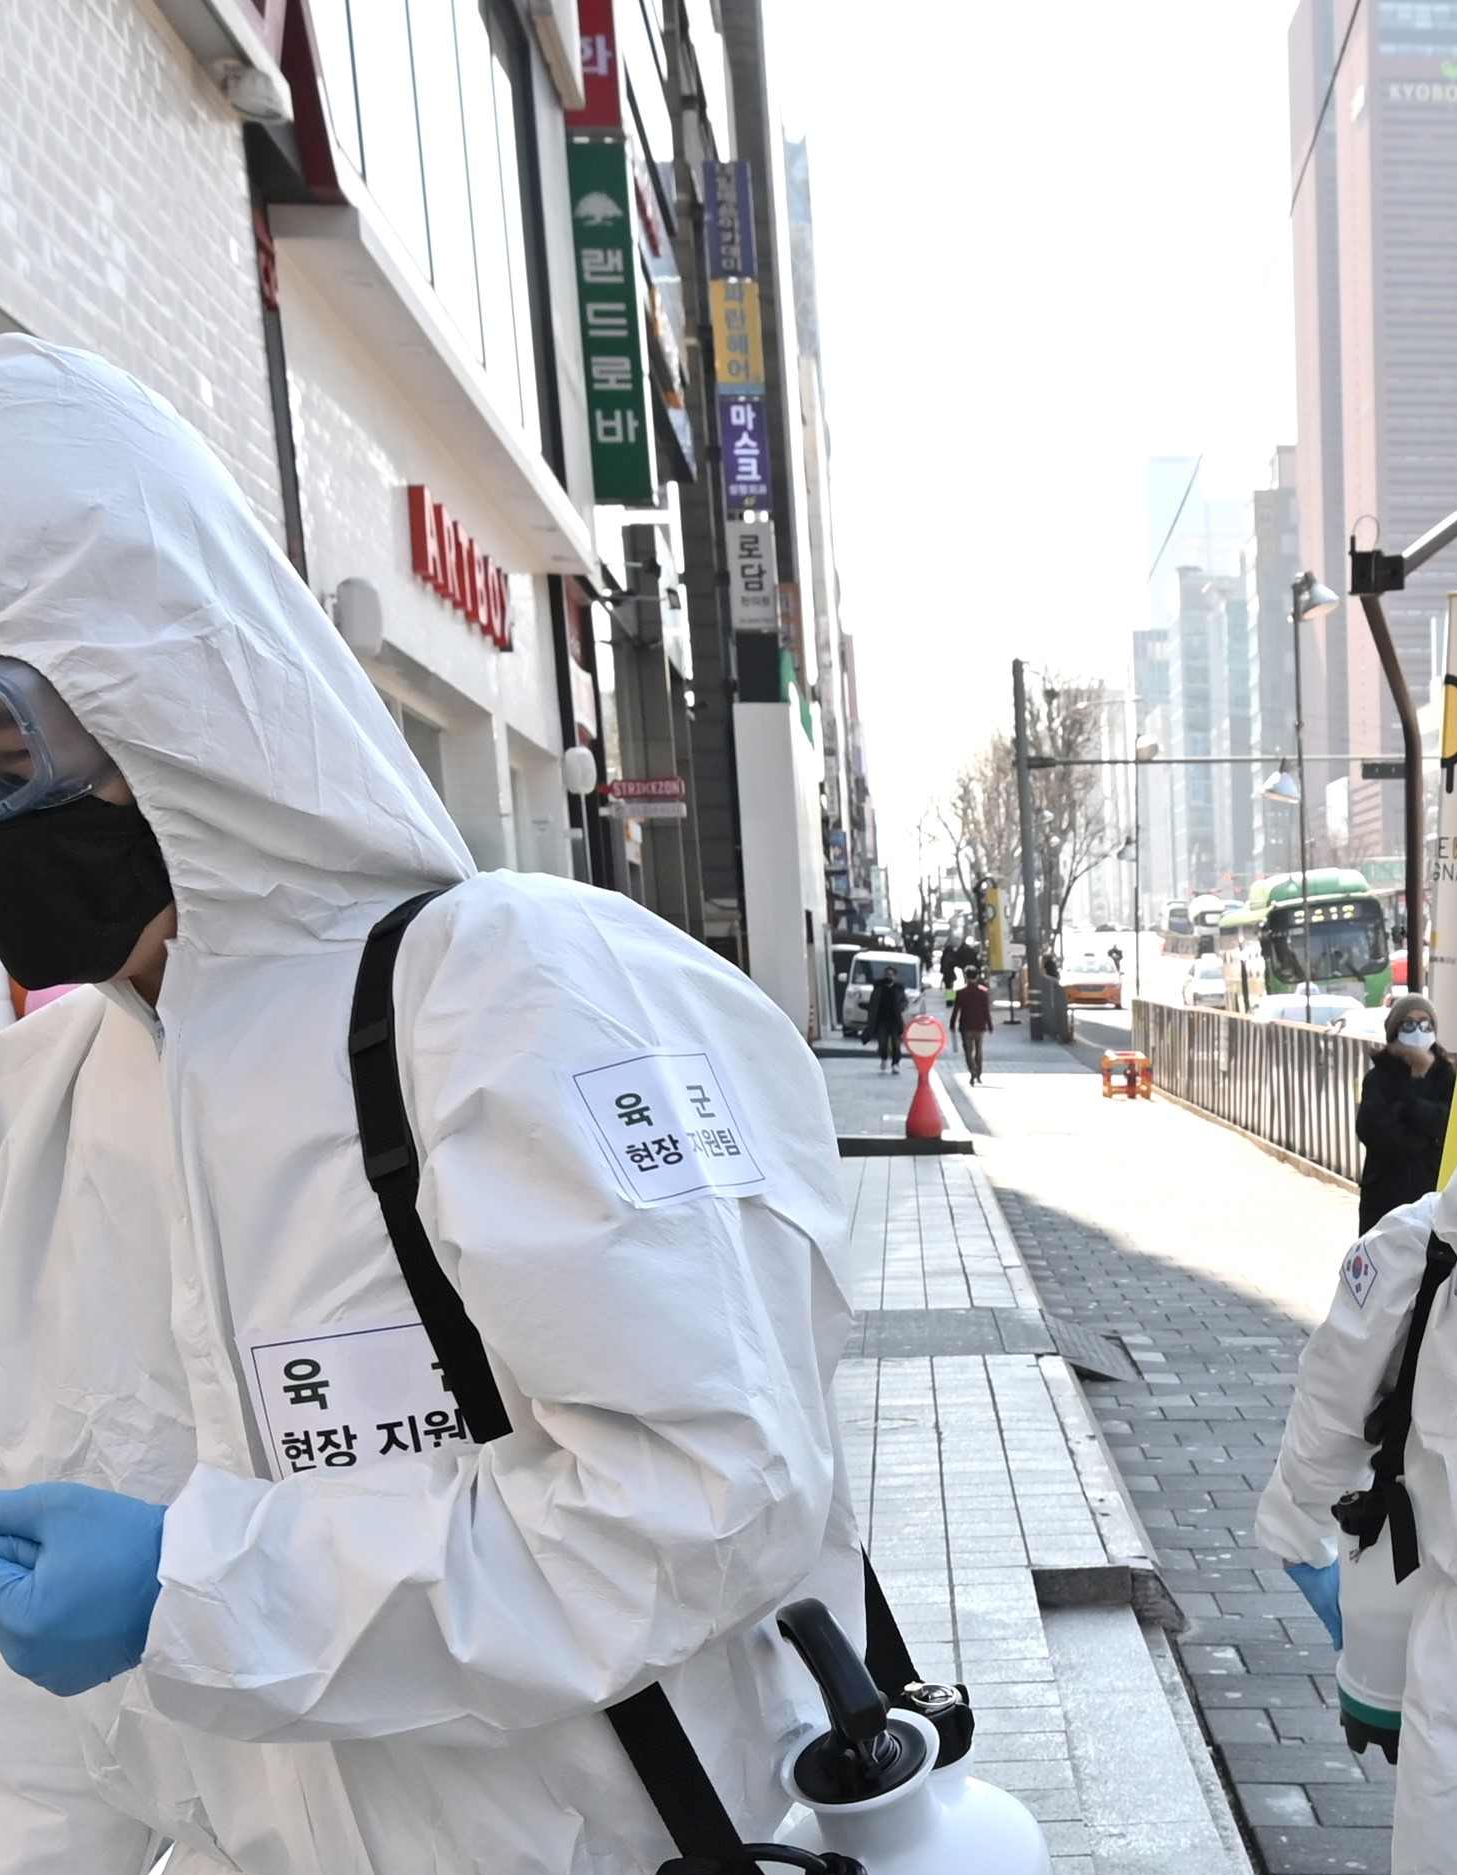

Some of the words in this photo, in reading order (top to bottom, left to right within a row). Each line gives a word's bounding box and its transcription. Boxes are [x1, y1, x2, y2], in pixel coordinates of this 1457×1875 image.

[730, 403, 762, 482] 마스크
[409, 485, 514, 652] ARTBOX
[614, 1092, 655, 1129] 육
[685, 1083, 717, 1119] 군
[624, 1136, 685, 1174] 현장
[691, 1123, 743, 1160] 지원팀
[282, 1357, 331, 1411] 육
[280, 1424, 359, 1473] 현장
